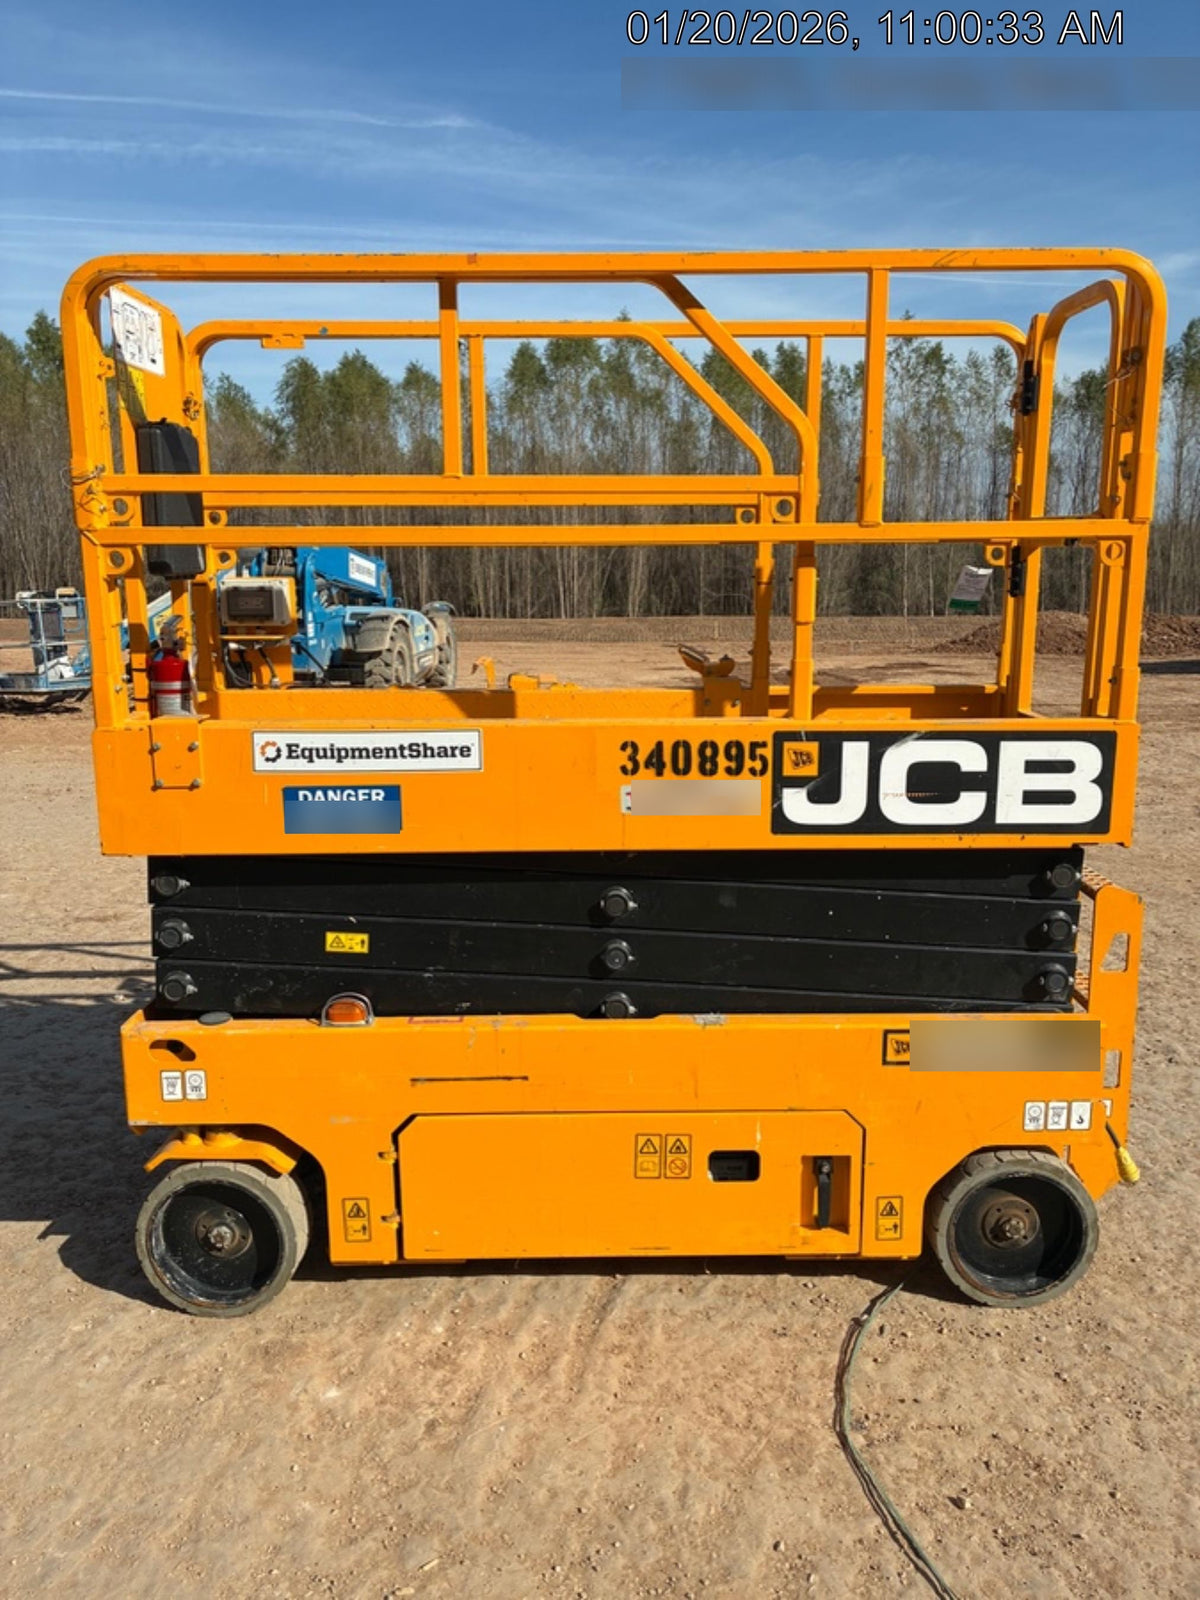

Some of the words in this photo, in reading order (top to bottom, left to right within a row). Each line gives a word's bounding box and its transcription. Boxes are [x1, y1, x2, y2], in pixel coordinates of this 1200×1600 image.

[285, 742, 472, 763] EquipmentShare
[619, 739, 769, 777] 340895
[782, 740, 1103, 825] JCB
